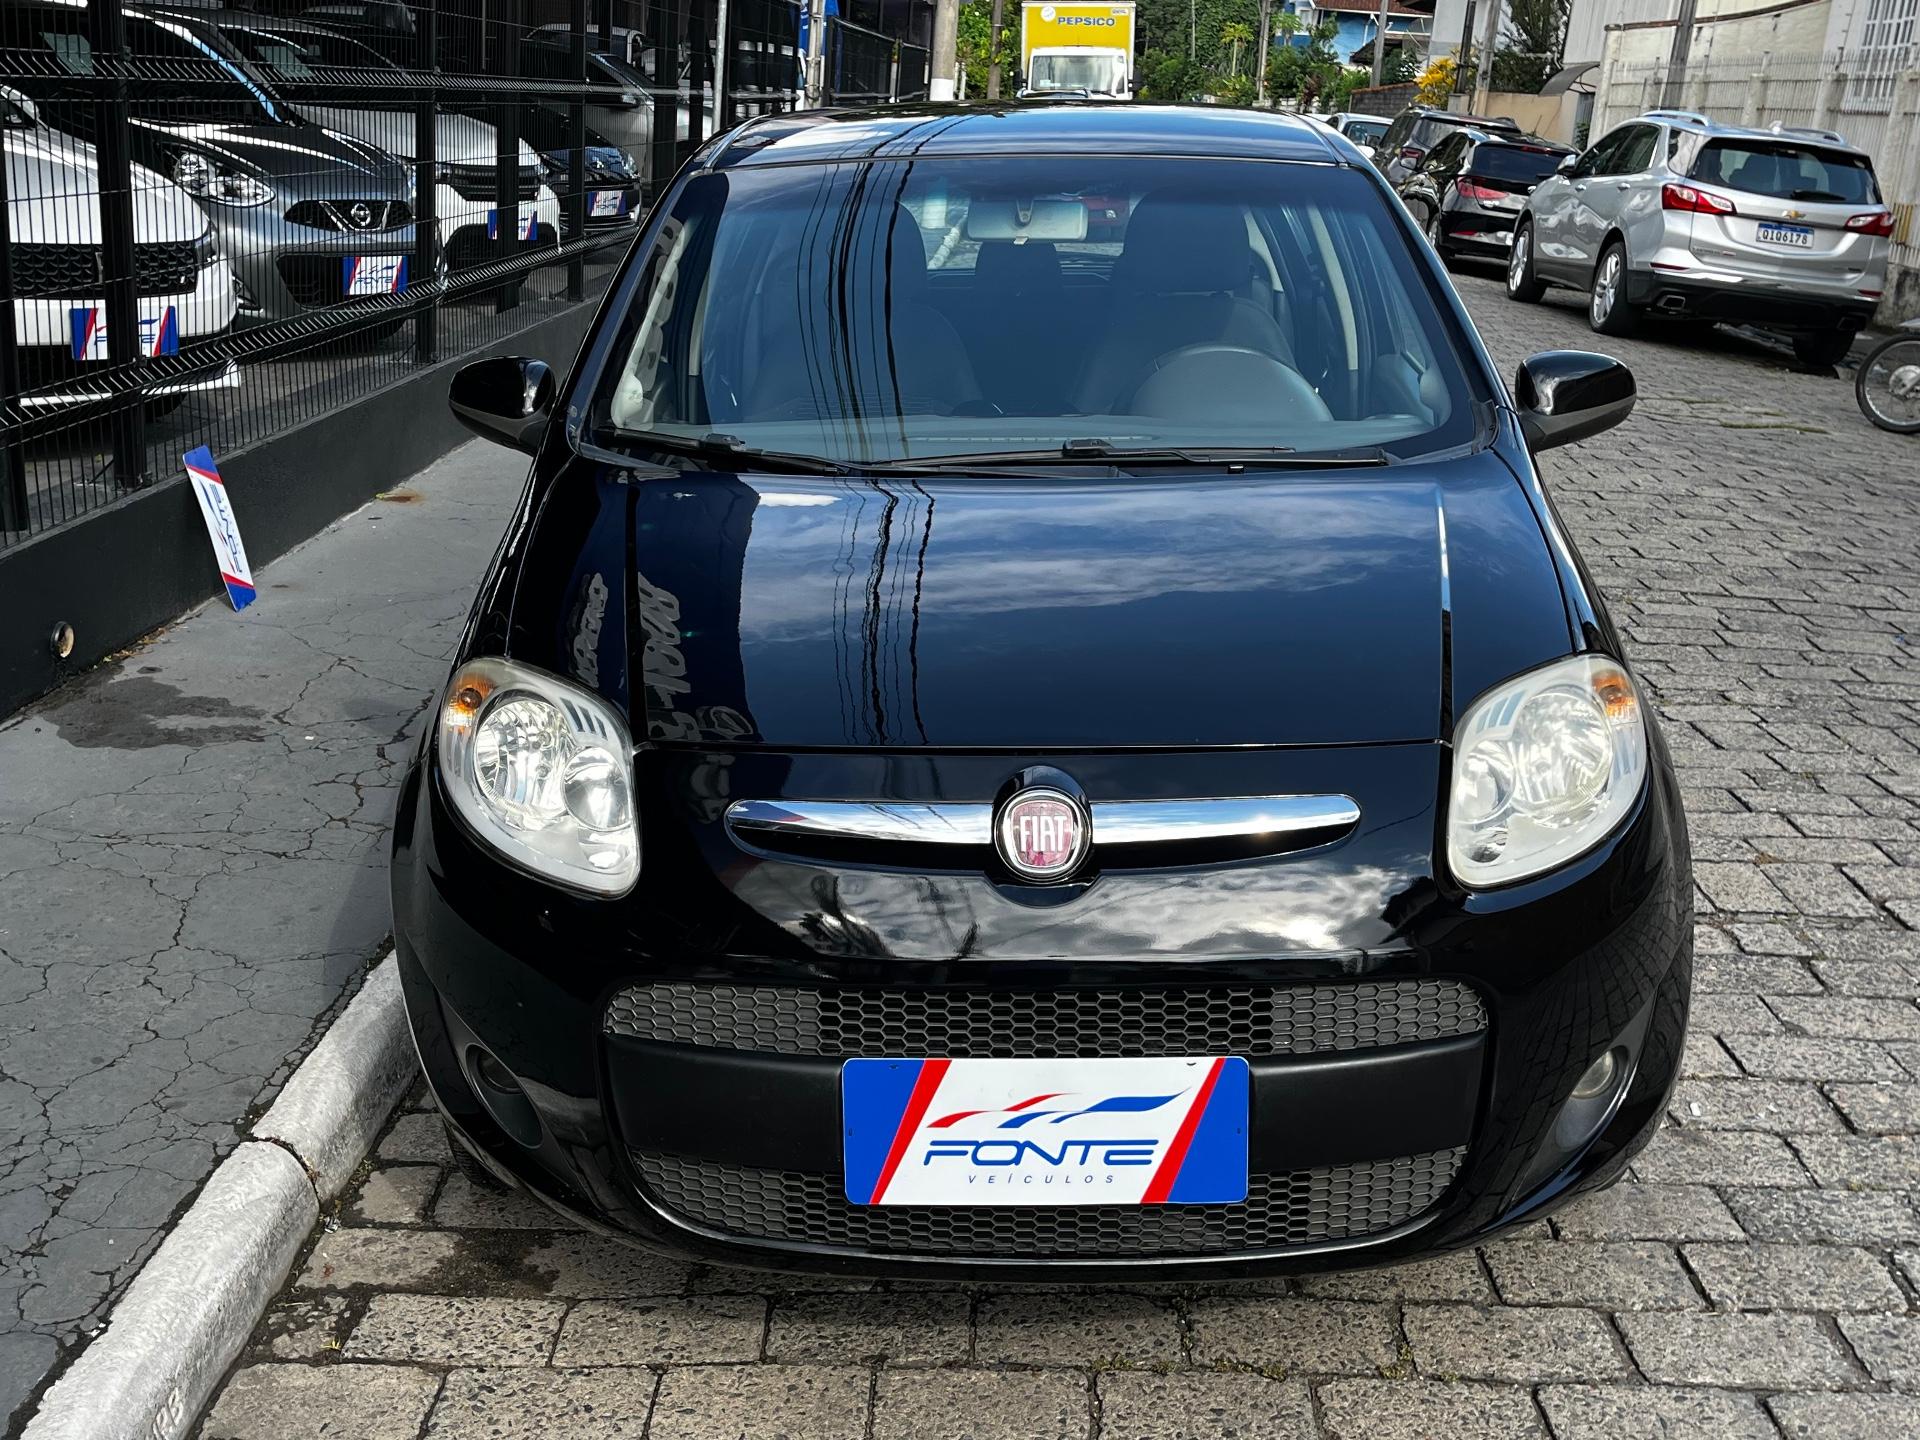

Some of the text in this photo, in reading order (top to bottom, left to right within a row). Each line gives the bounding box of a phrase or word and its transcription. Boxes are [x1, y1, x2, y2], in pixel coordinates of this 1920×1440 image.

[1057, 16, 1116, 27] PEPSICO
[1020, 815, 1068, 852] FIAT
[923, 1139, 1160, 1167] FONTE
[968, 1173, 1114, 1184] VEÍCULOS
